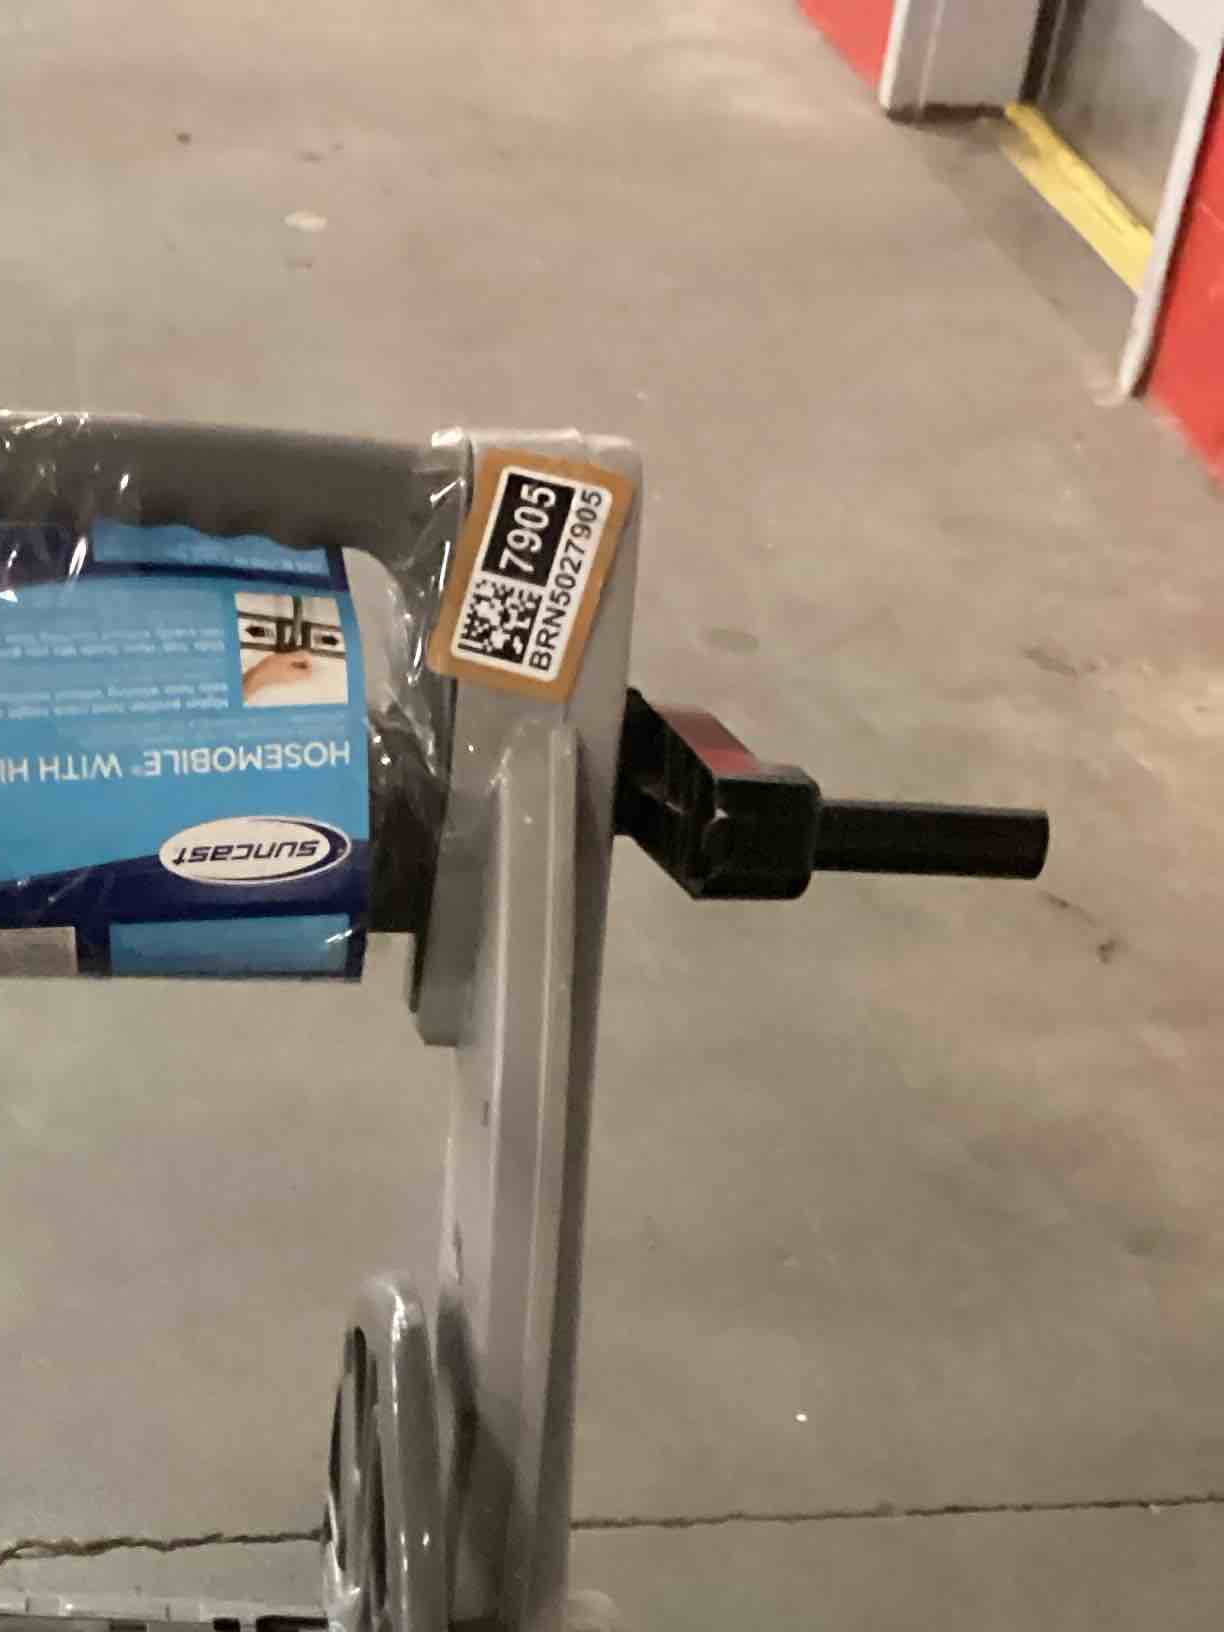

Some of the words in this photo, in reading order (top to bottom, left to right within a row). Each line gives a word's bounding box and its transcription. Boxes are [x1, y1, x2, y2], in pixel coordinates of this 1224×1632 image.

[498, 483, 558, 574] 7905
[529, 490, 602, 671] BRN5027905
[37, 752, 121, 780] WITH
